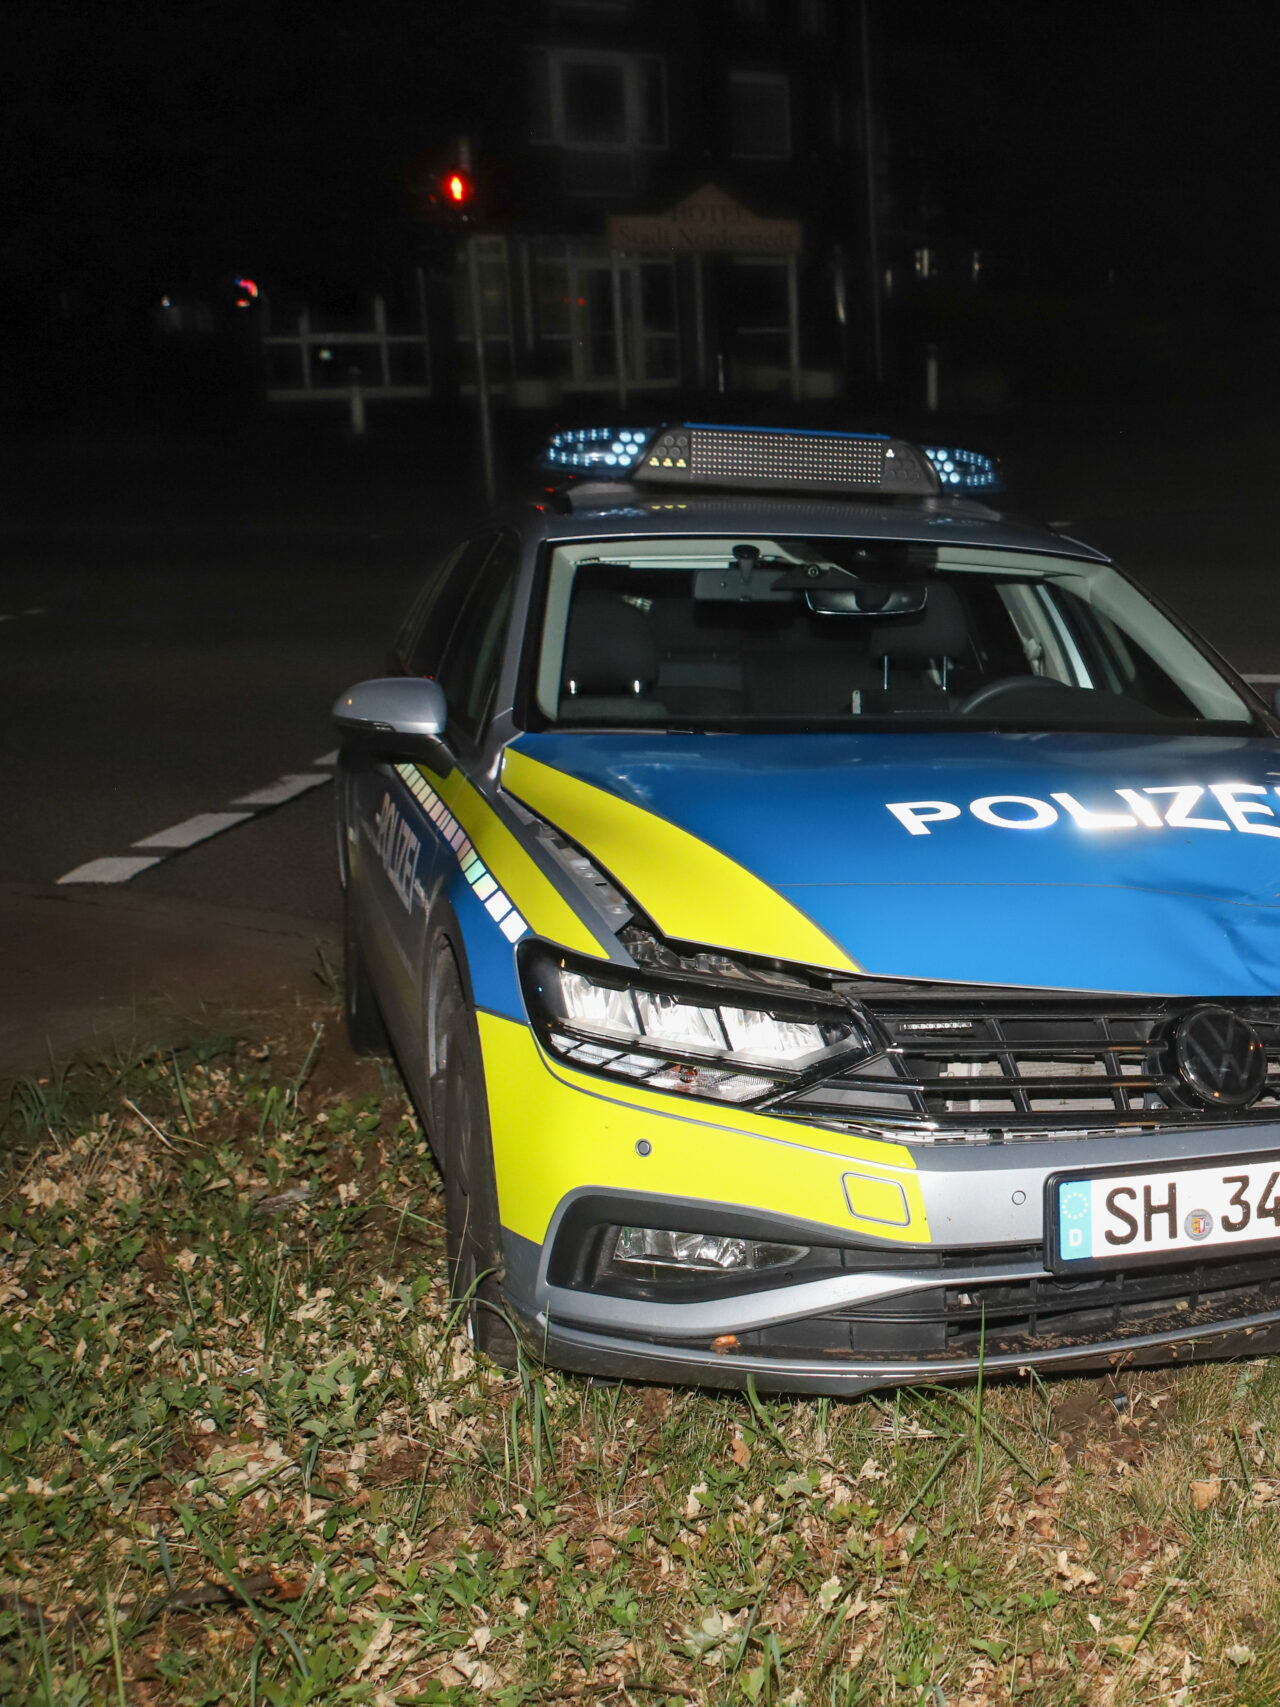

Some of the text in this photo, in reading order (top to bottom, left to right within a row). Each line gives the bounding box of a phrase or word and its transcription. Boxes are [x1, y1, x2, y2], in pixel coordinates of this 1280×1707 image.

[375, 792, 421, 915] POLIZEI
[1068, 1228, 1083, 1248] D
[1105, 1182, 1177, 1245] SH
